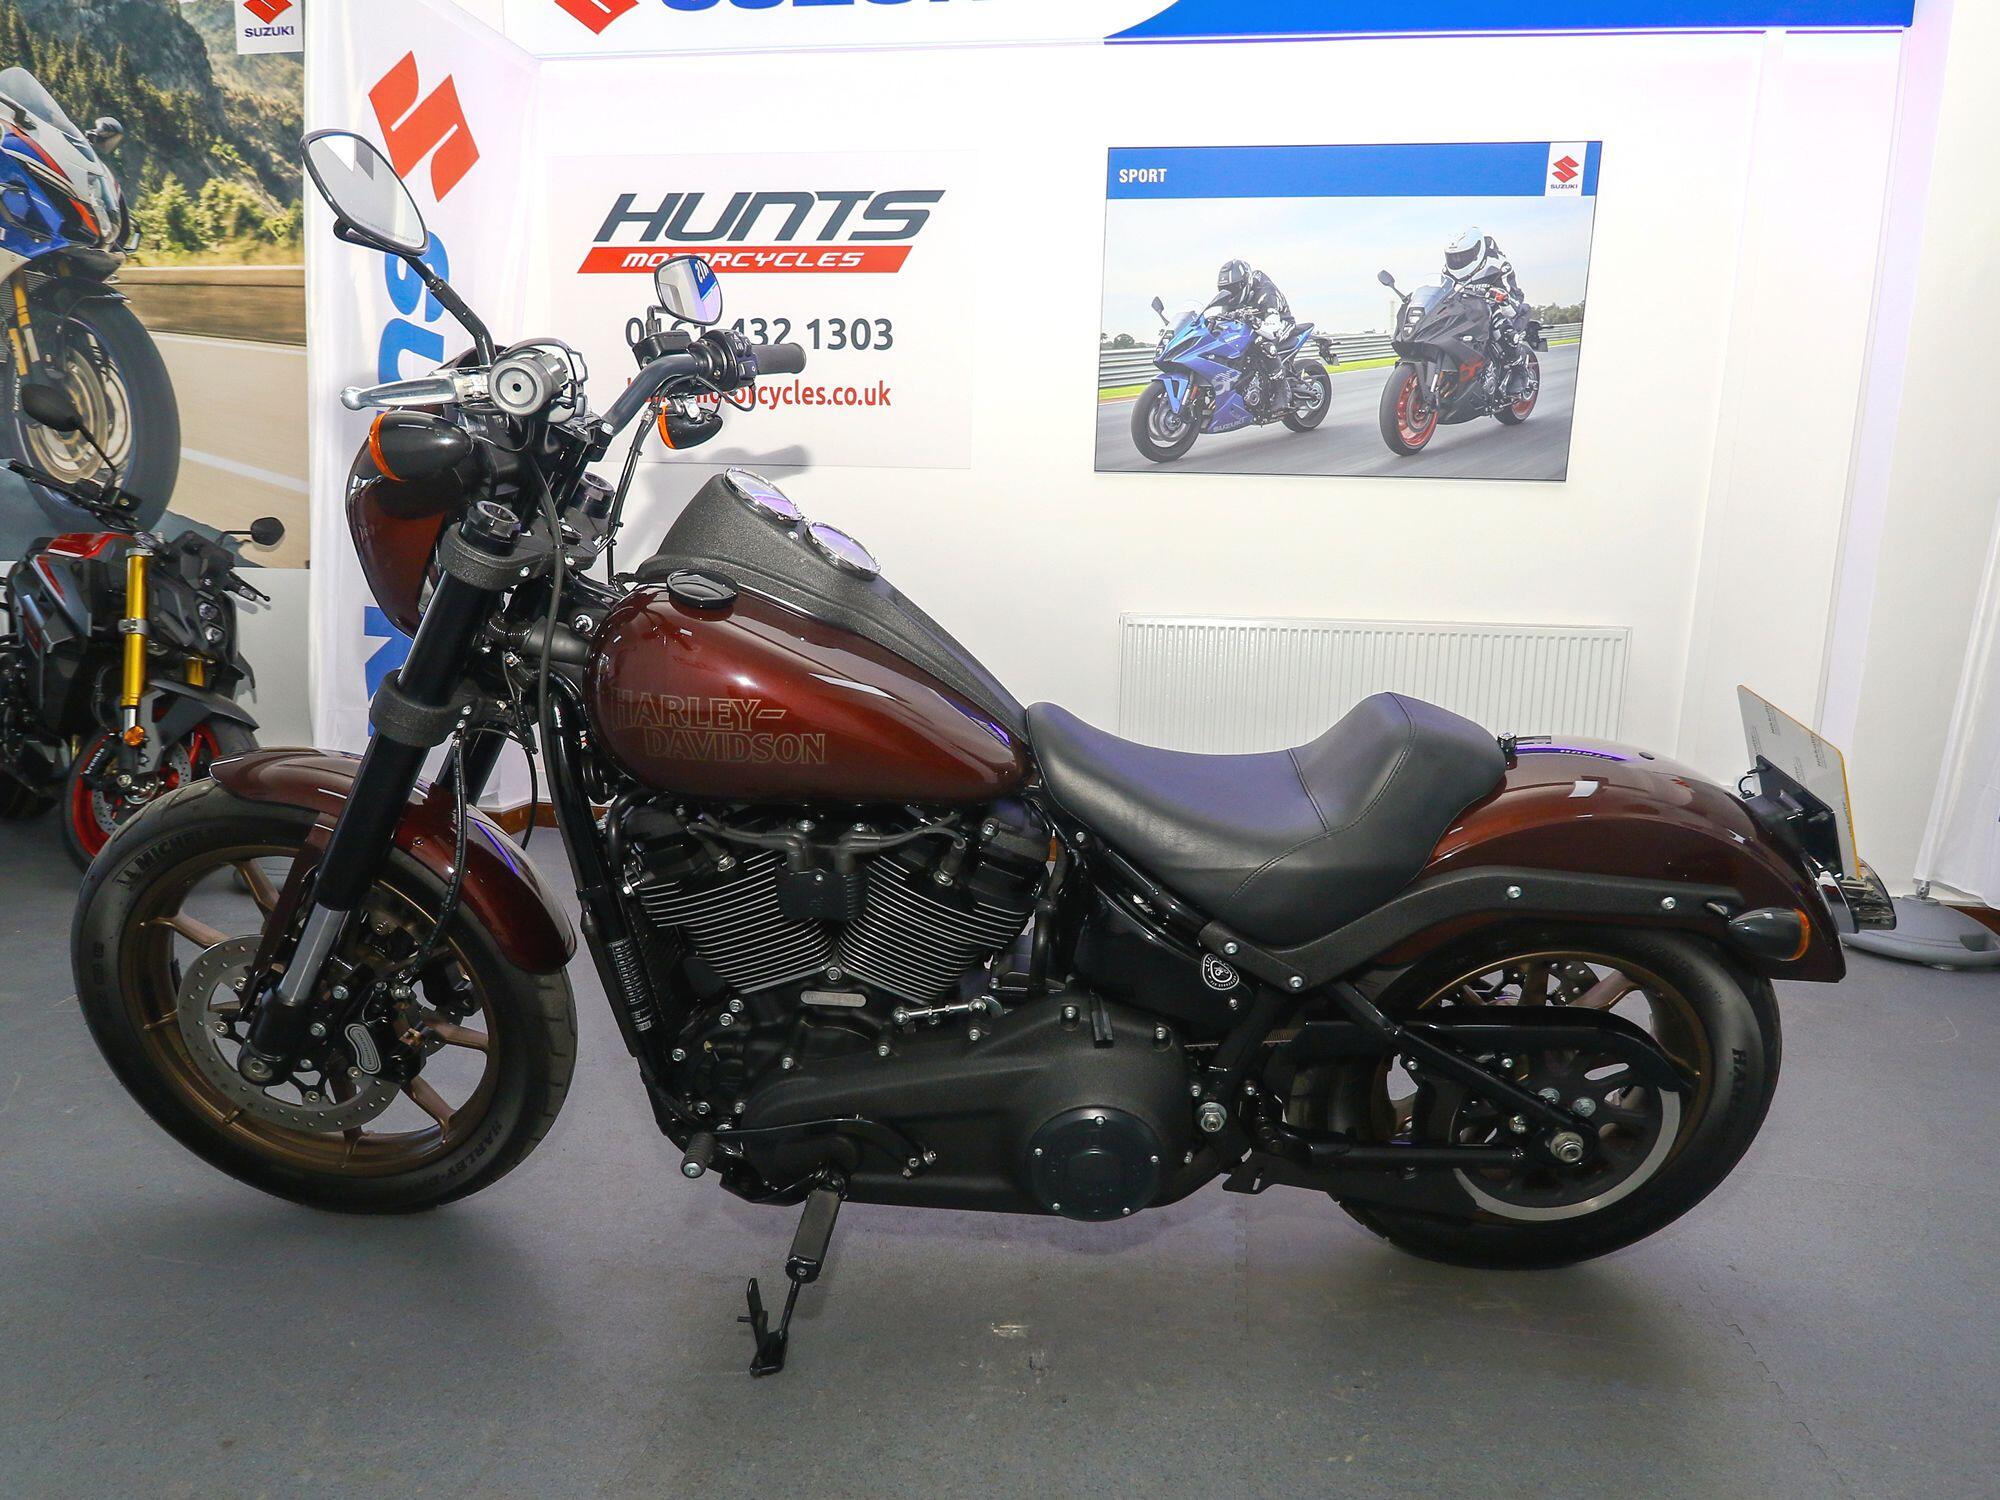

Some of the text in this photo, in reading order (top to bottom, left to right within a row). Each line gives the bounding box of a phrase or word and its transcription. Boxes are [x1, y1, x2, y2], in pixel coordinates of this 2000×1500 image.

[244, 25, 295, 38] SUZUKI
[1119, 168, 1167, 183] SPORT
[593, 189, 946, 242] HUNTS
[621, 252, 865, 268] MORCYCLES
[807, 318, 893, 350] 1303
[609, 687, 787, 731] HARLEY-
[643, 727, 826, 765] DAVIDSON
